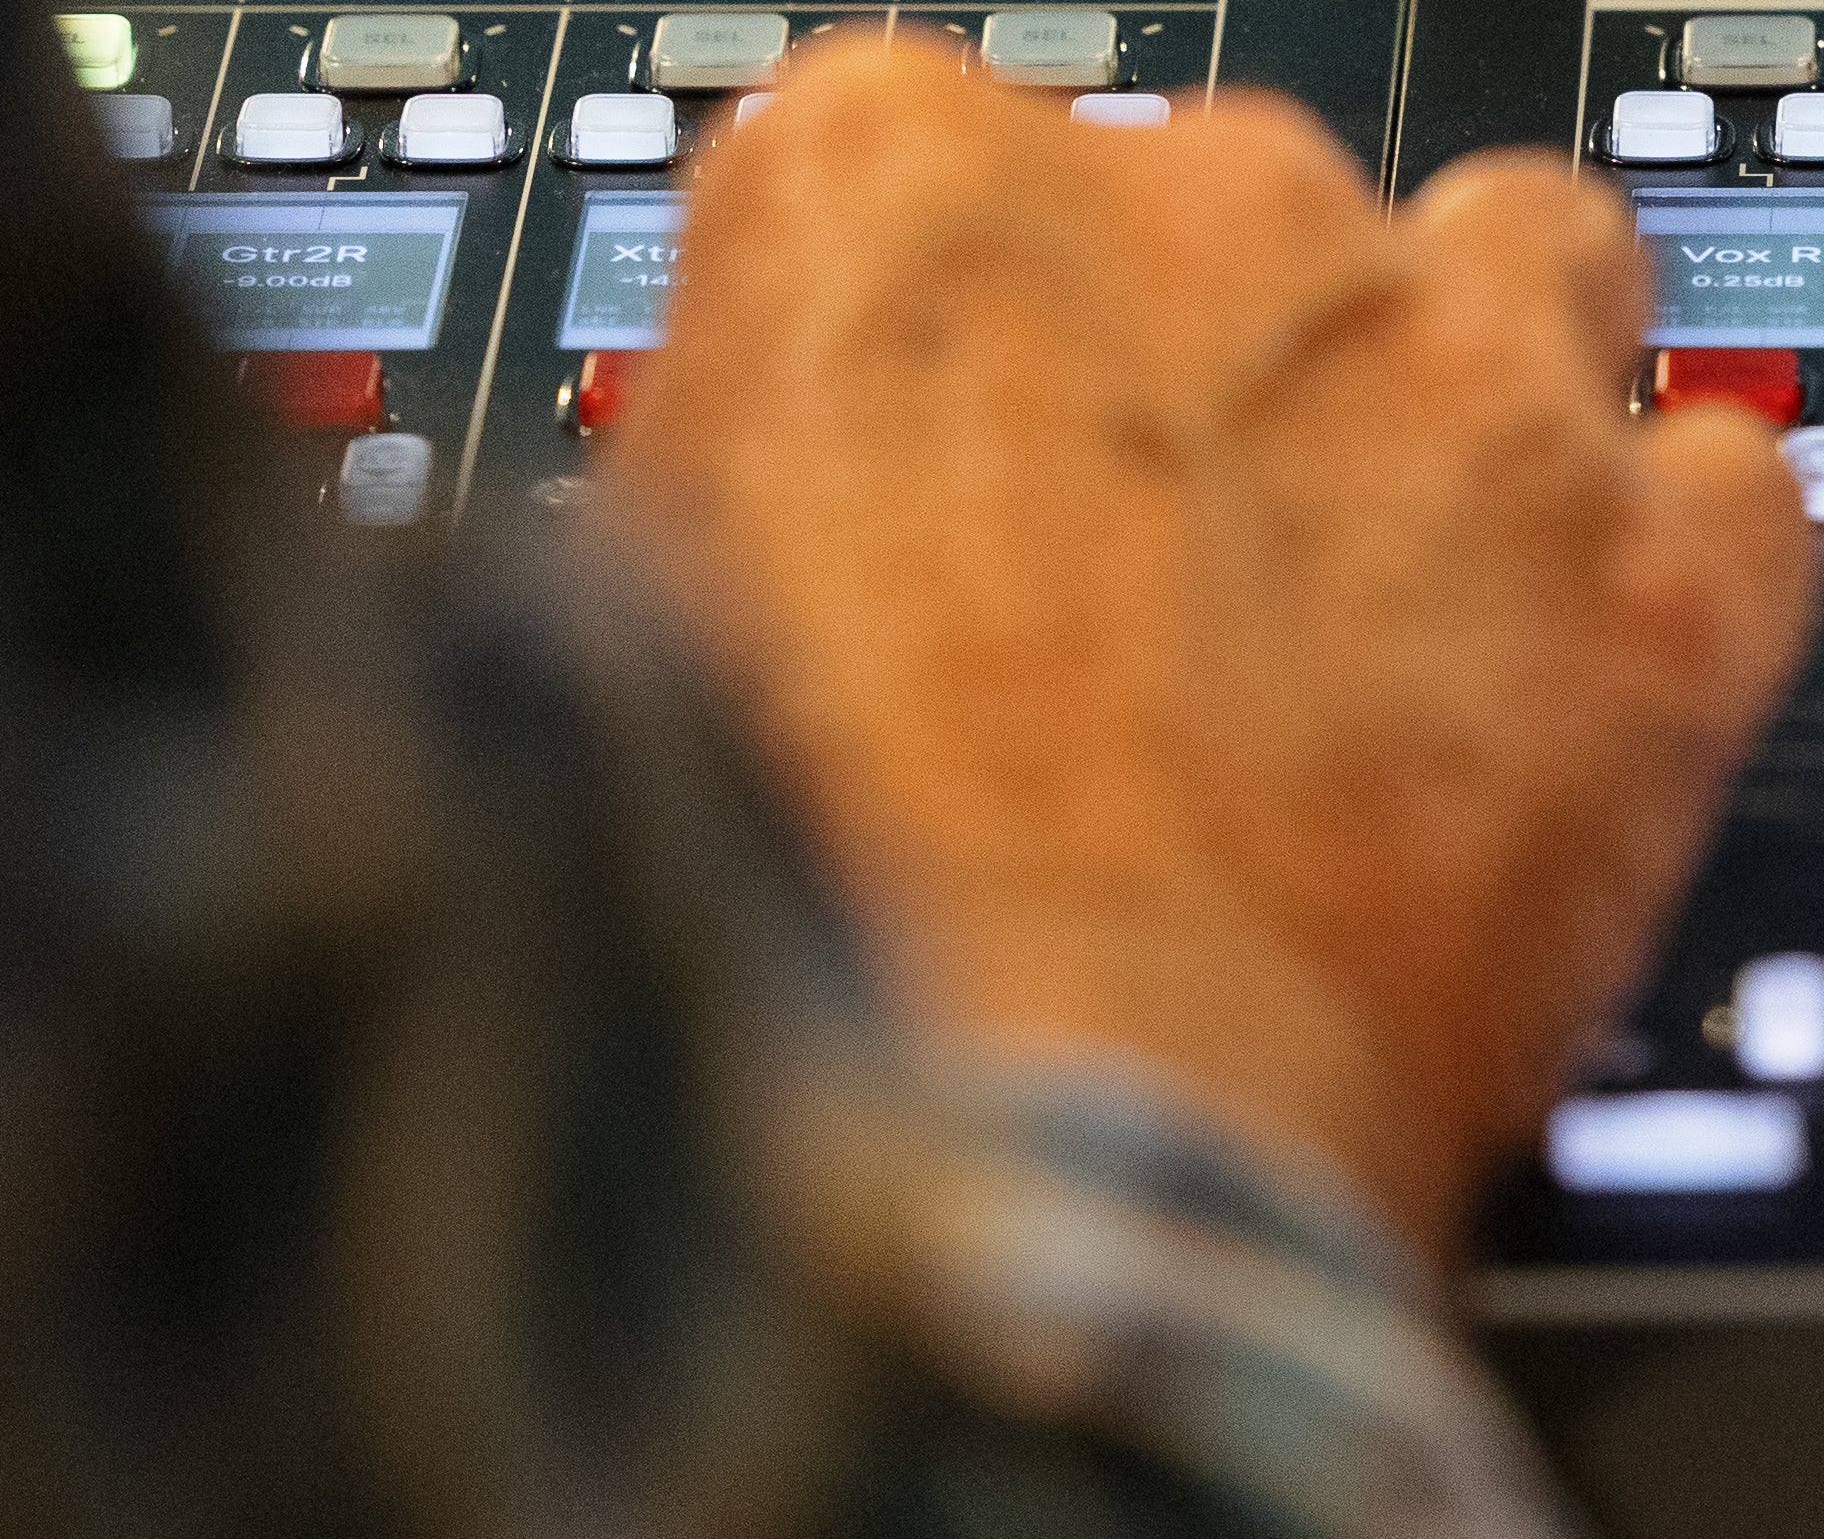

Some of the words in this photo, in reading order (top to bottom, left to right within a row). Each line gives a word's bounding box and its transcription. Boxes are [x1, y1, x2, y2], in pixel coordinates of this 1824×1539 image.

[221, 244, 368, 264] Gtr2R
[1680, 246, 1773, 264] Vox
[1791, 246, 1822, 264] R
[222, 274, 353, 288] -9.00dB
[1690, 274, 1806, 288] 0.25dB
